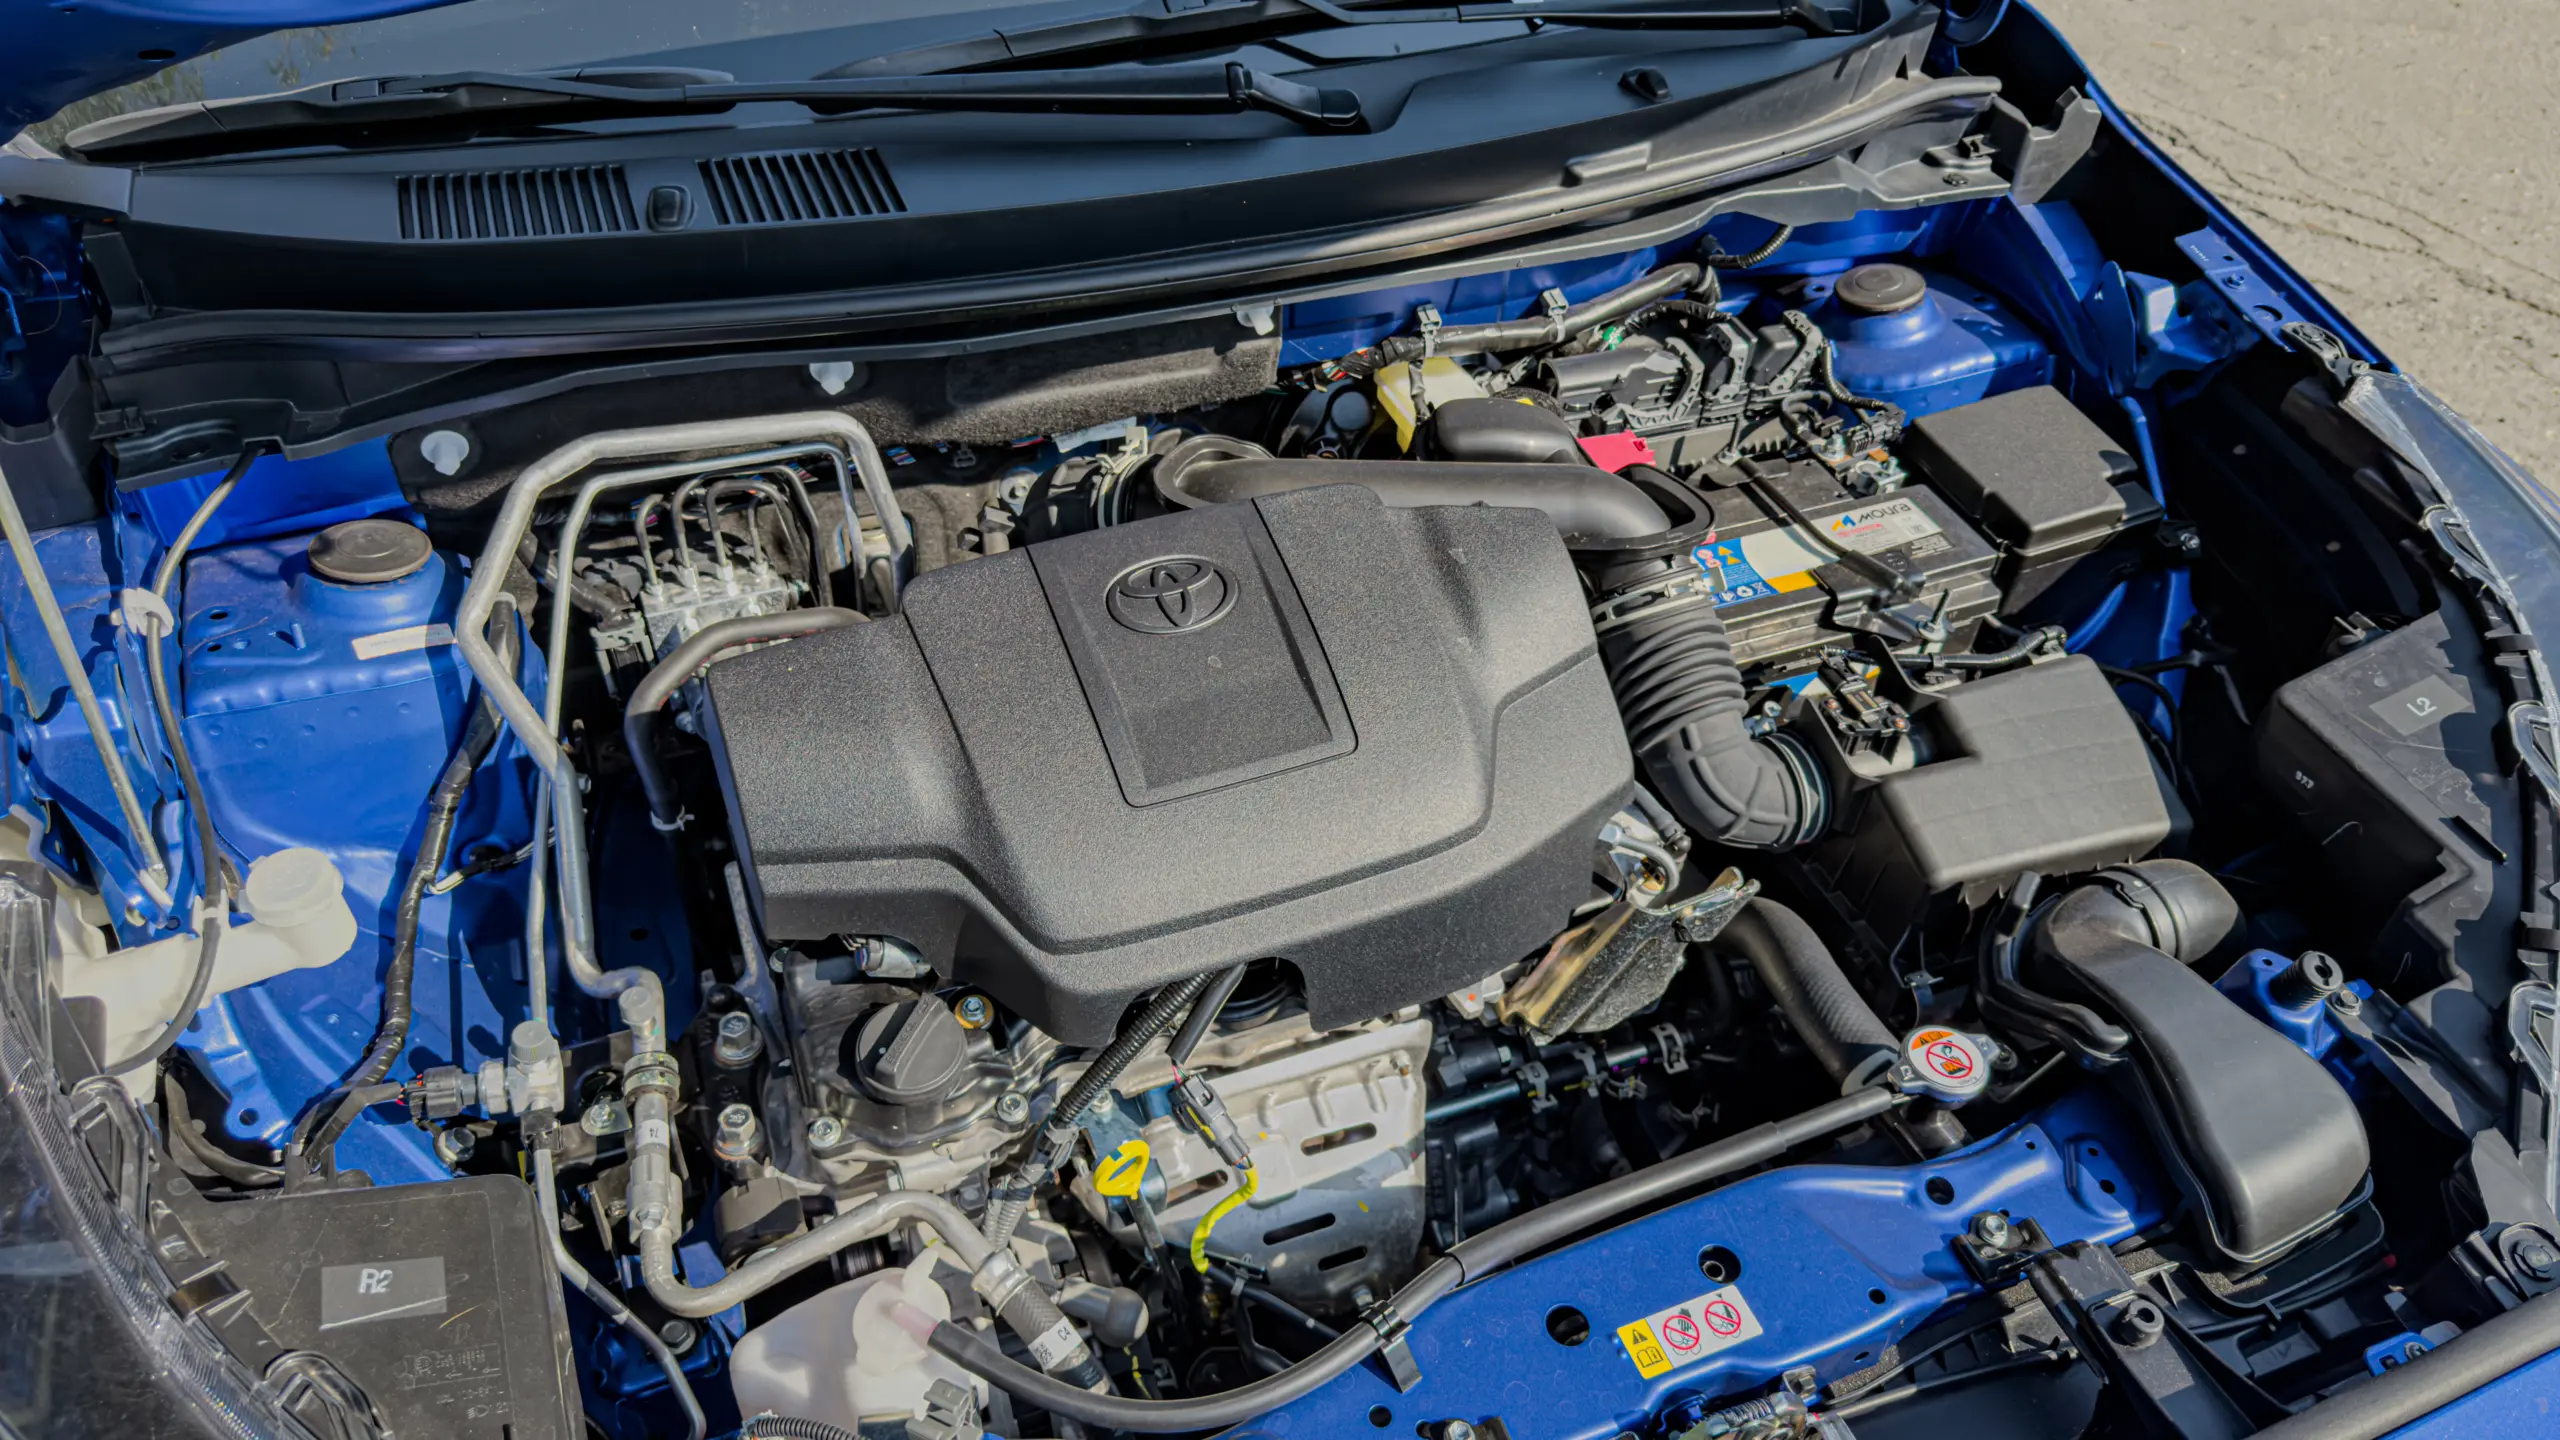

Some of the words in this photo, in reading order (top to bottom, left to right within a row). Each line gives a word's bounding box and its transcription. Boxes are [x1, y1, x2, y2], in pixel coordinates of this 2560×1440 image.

[2406, 696, 2438, 717] L2
[358, 1268, 394, 1295] R2
[1057, 1325, 1072, 1341] C4
